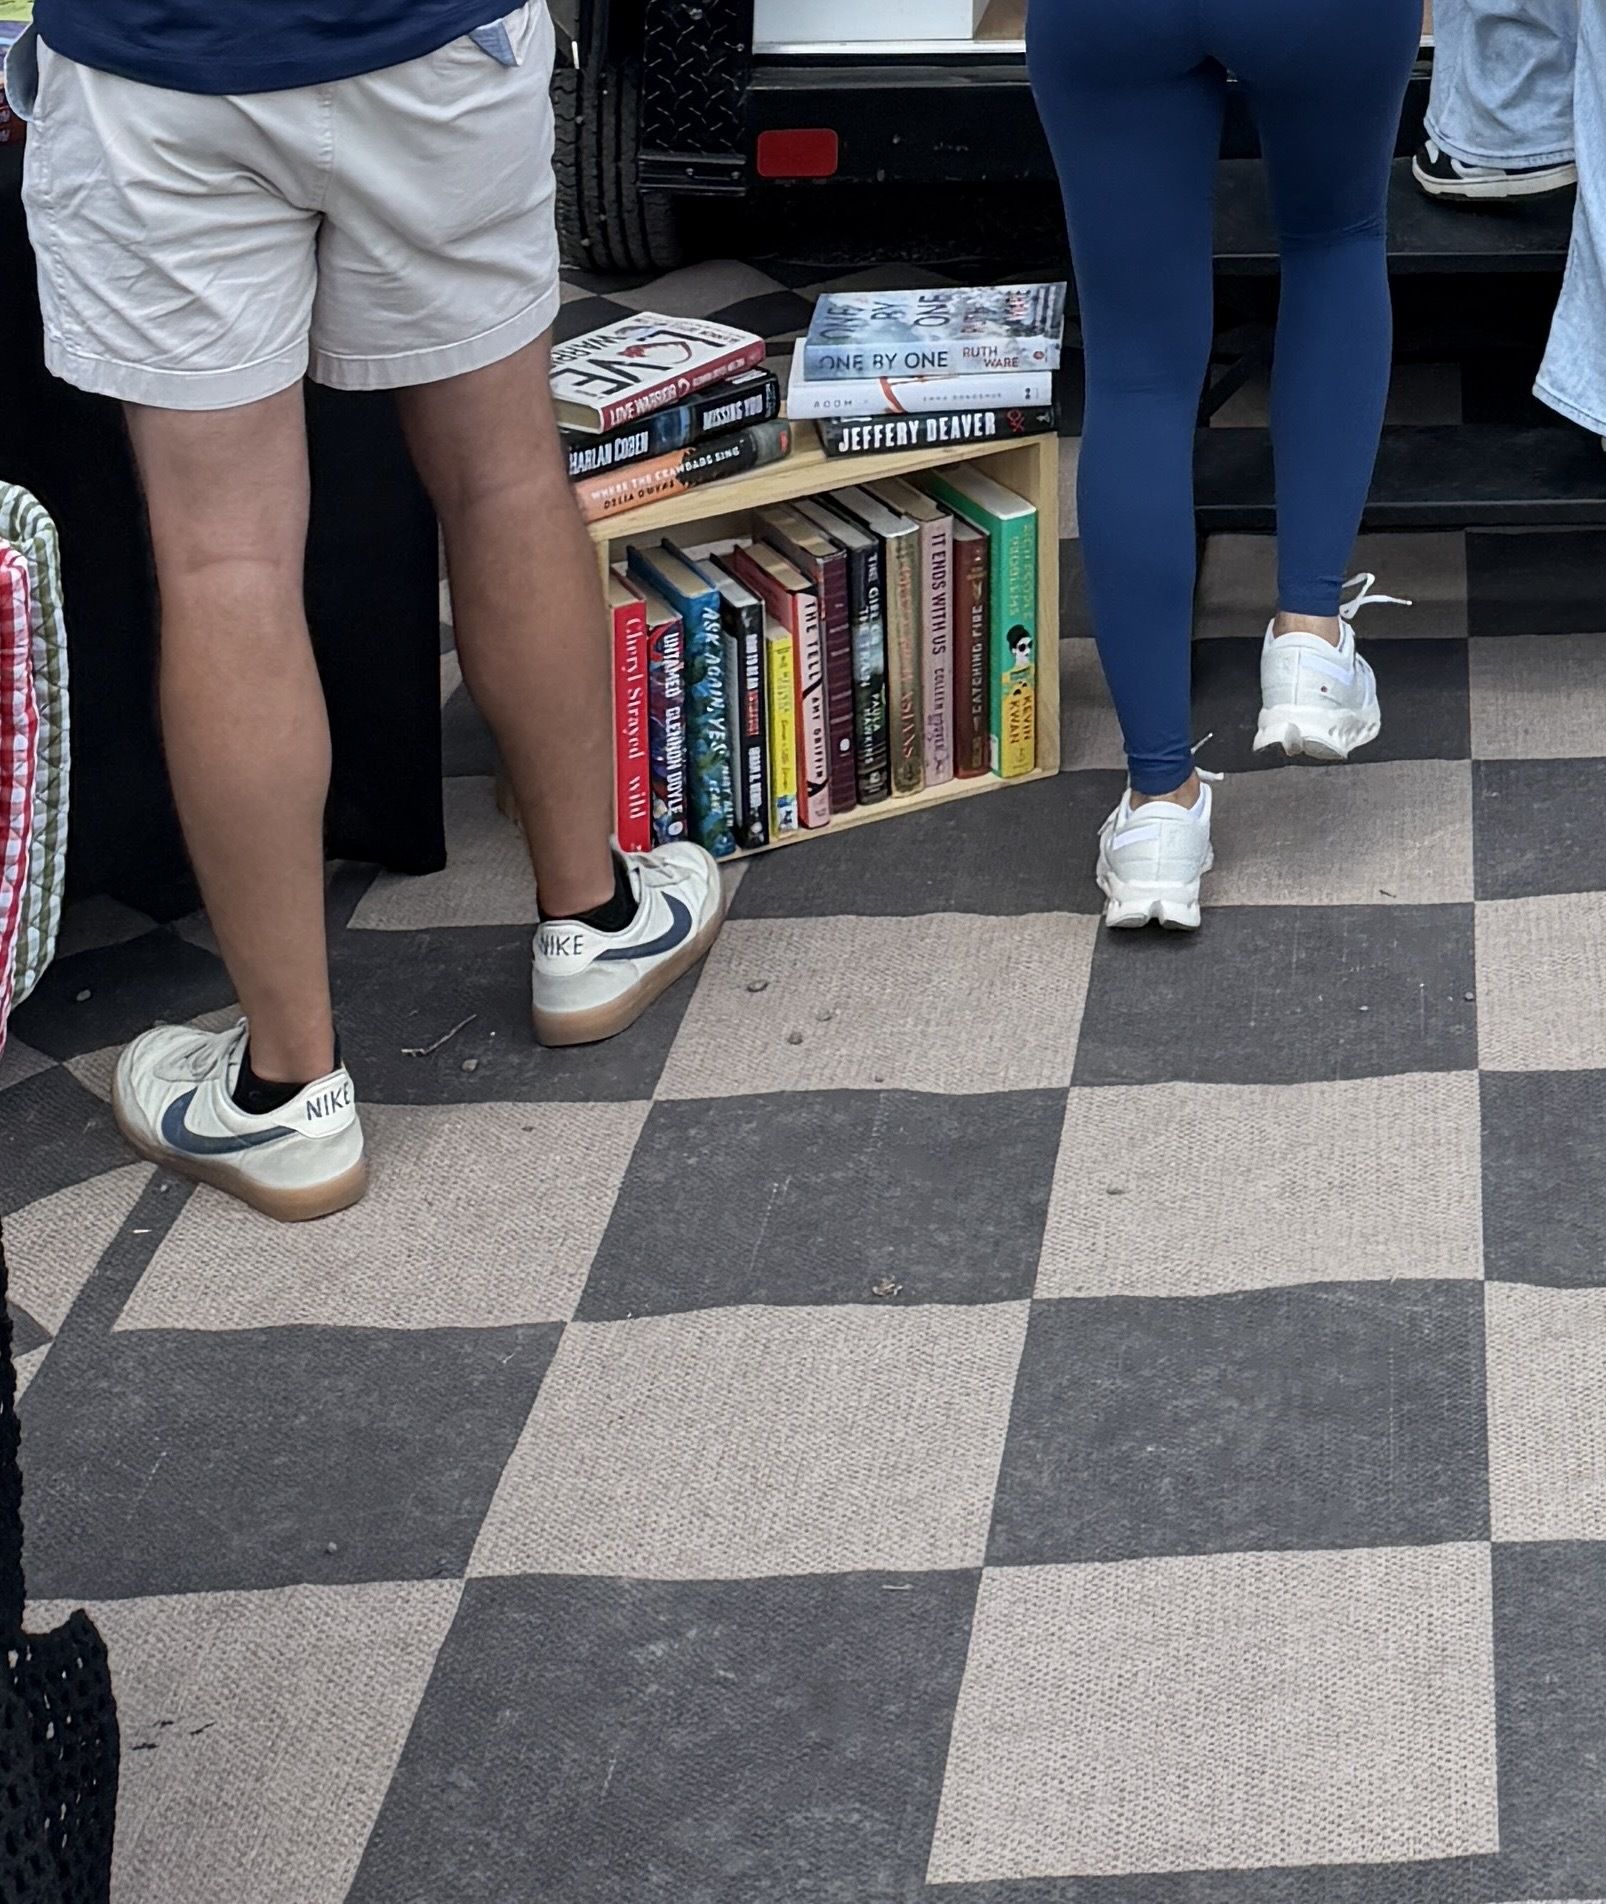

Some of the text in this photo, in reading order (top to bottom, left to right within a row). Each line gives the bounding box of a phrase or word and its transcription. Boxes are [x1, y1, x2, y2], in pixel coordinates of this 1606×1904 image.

[913, 295, 950, 328] ONE
[819, 349, 949, 372] ONE BY ONE
[962, 346, 998, 359] RUTH
[983, 356, 1020, 369] WARE
[609, 398, 636, 428] LOVE
[702, 393, 764, 431] MISSING YOU
[838, 410, 997, 453] JEFFERY DEAVER
[569, 430, 649, 476] HARLAN COBEN
[591, 479, 628, 501] WHERE
[631, 472, 653, 489] THE
[715, 445, 741, 463] SING
[603, 493, 635, 510] DELIA
[867, 553, 879, 583] THE
[868, 586, 880, 620] GIRL
[931, 532, 947, 656] IT ENDS WITH US
[622, 617, 645, 683] Cheryl
[804, 601, 822, 681] THE TELL
[971, 604, 984, 715] CATCHING FIRE
[702, 606, 728, 755] ASK AGAIN, YES
[622, 687, 646, 760] Strayed
[663, 632, 687, 816] UNTAMED GLENNON DOYLE
[870, 692, 882, 733] PAULA
[1008, 699, 1020, 745] KWAN
[1022, 695, 1033, 741] KEVIN
[811, 696, 825, 779] AMY GRIFFIN
[863, 707, 874, 765] HAWKINS
[539, 933, 584, 956] NIKE
[306, 1085, 351, 1121] NIKE
